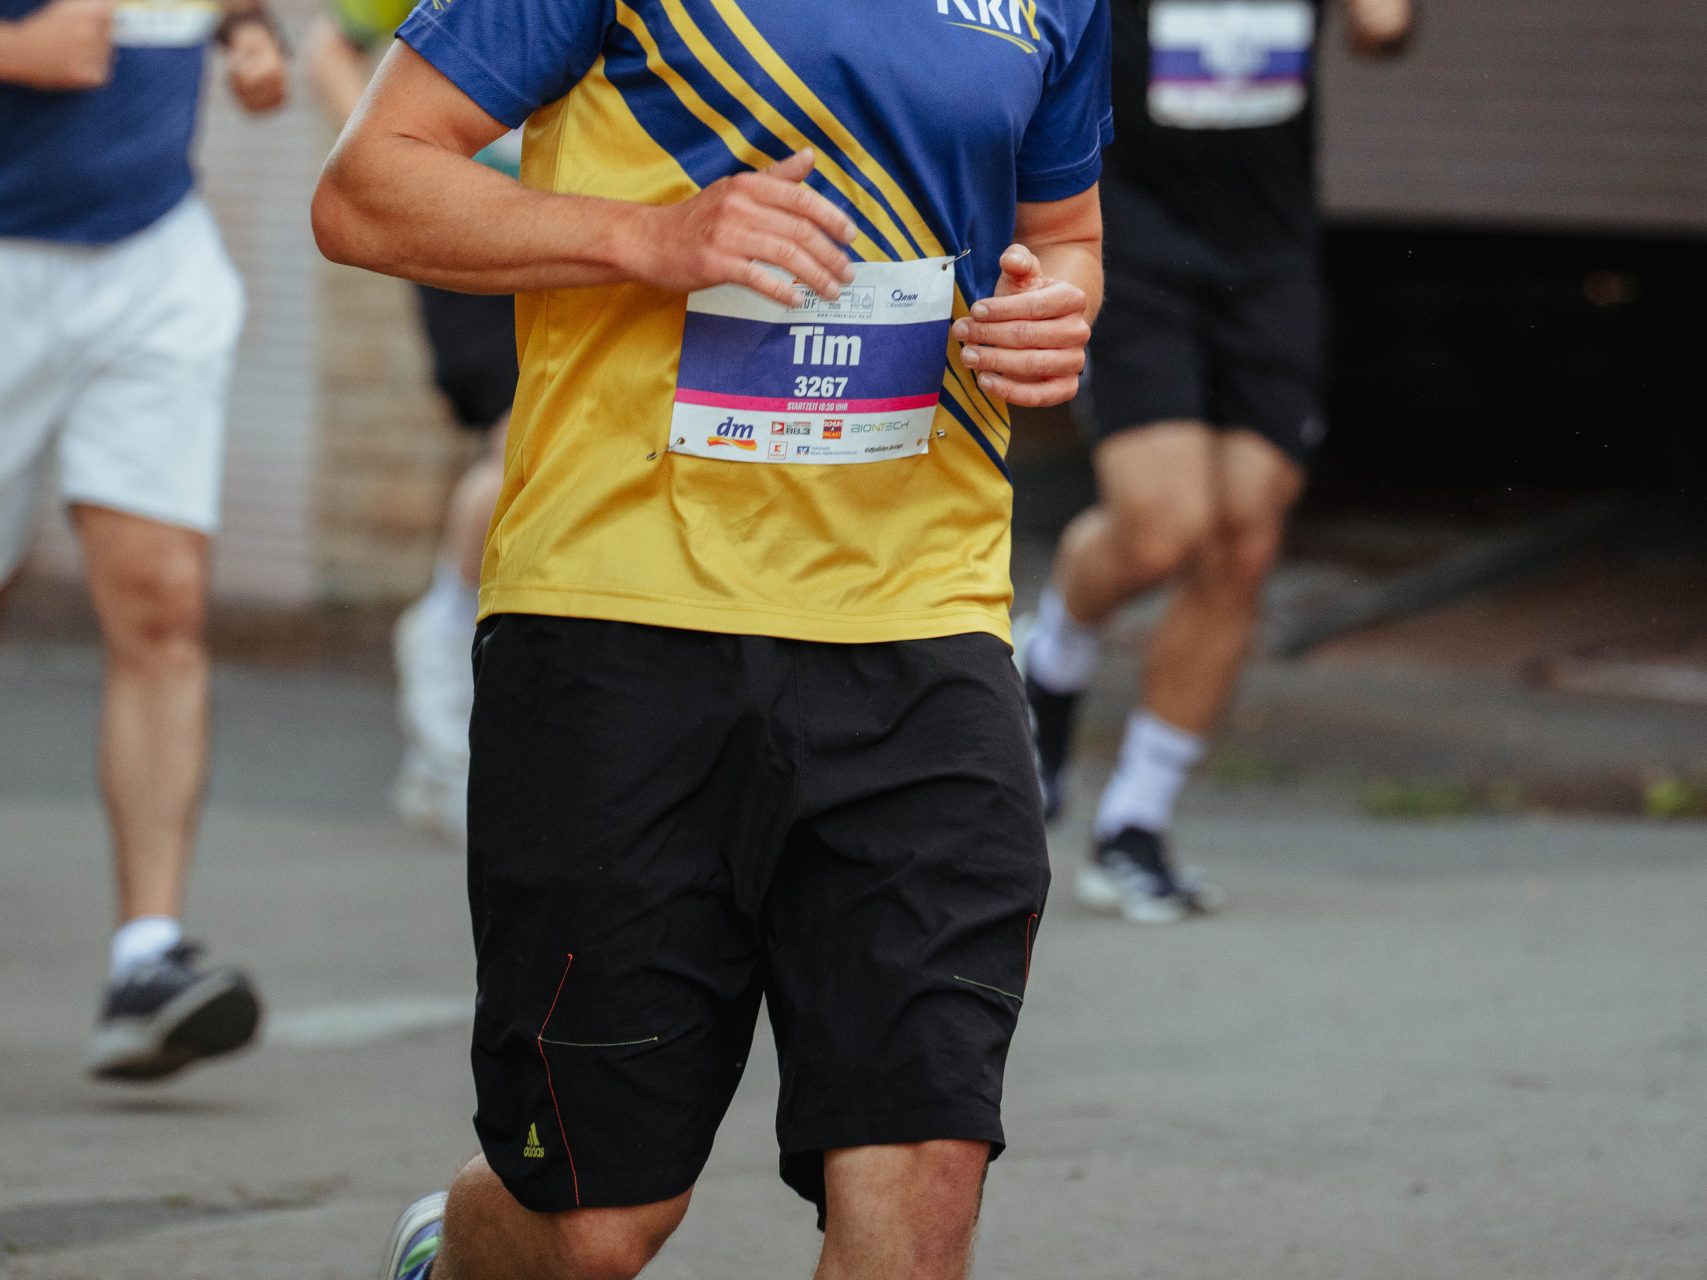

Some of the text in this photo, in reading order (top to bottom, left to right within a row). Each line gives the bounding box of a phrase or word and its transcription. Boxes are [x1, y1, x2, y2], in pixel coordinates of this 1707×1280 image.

[789, 326, 862, 366] Tim
[793, 376, 848, 398] 3267
[835, 403, 848, 411] UHR
[716, 416, 754, 438] dm
